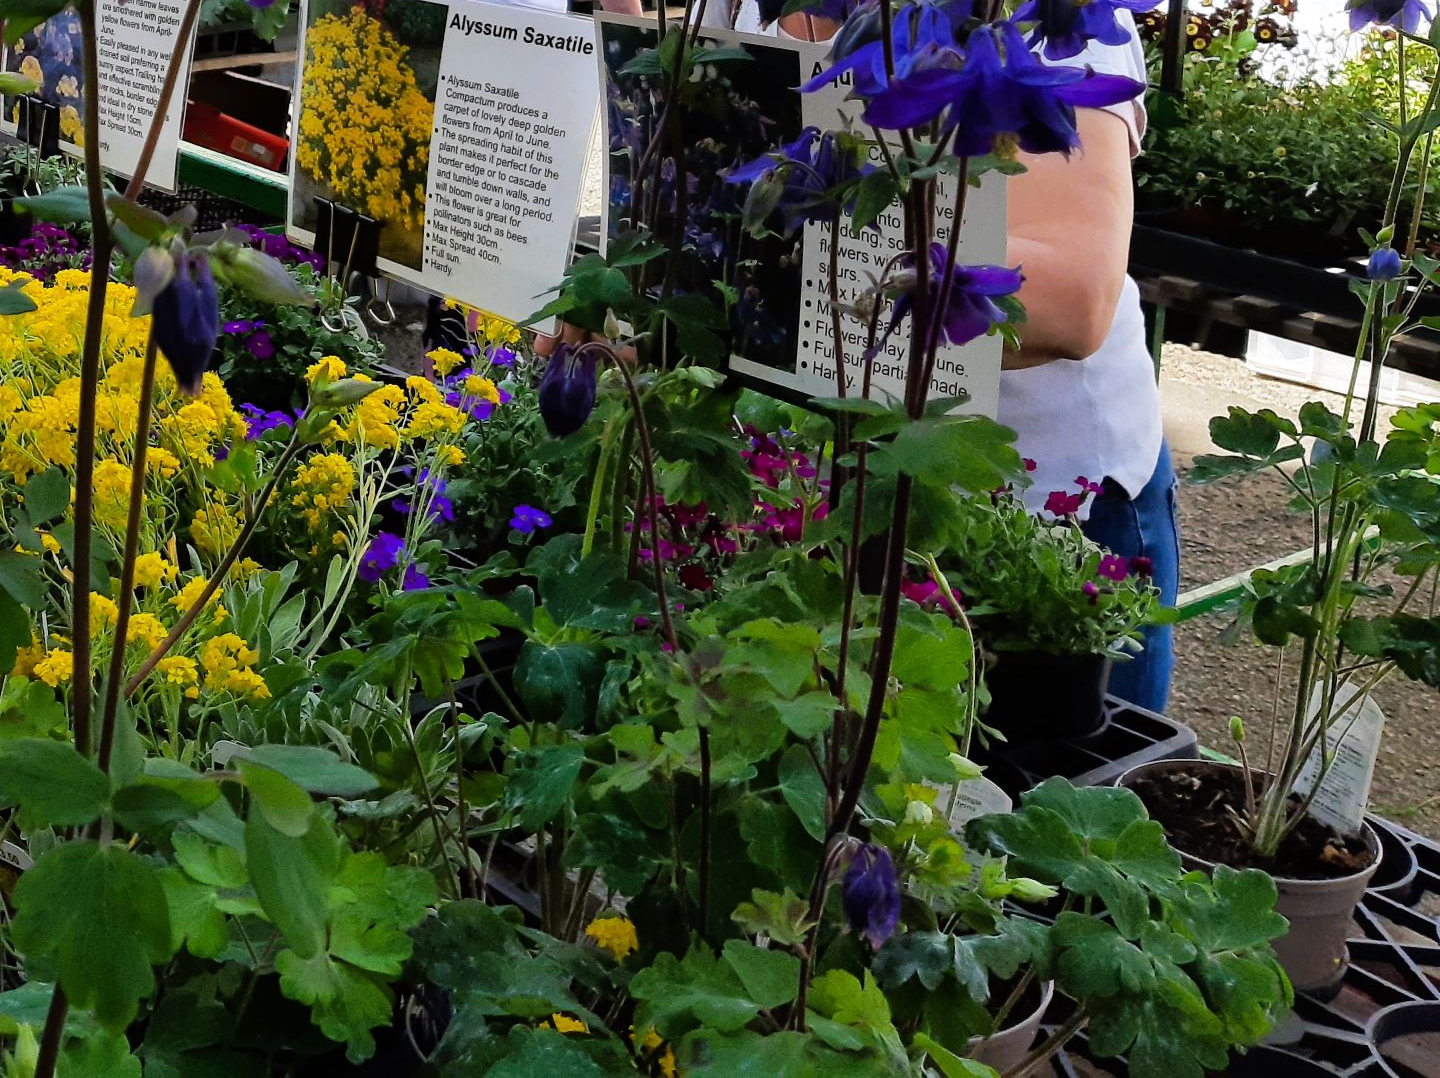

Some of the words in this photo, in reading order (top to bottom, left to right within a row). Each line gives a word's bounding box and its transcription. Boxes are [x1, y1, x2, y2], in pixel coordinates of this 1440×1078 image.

[141, 23, 155, 33] from
[144, 11, 156, 21] with
[158, 14, 180, 27] golden
[449, 13, 518, 41] Alyssum
[523, 27, 594, 55] Saxatile
[117, 40, 140, 54] pleased
[147, 49, 159, 60] any
[447, 75, 482, 90] Alyssum
[484, 83, 520, 99] Saxatile
[445, 88, 495, 108] Compactum
[498, 102, 539, 118] produces
[542, 112, 548, 120] a
[442, 114, 470, 130] flowers
[472, 121, 491, 135] from
[493, 127, 513, 141] April
[515, 132, 524, 142] to
[526, 135, 551, 150] June.
[444, 103, 469, 117] carpet
[471, 108, 480, 117] of
[481, 110, 506, 127] lovely
[509, 117, 531, 131] deep
[533, 123, 566, 138] golden
[441, 127, 456, 140] The
[458, 133, 498, 153] spreading
[500, 143, 523, 157] habit
[524, 149, 535, 159] of
[536, 152, 553, 164] this
[438, 154, 464, 169] border
[465, 161, 485, 176] edge
[487, 169, 496, 178] or
[498, 171, 506, 181] to
[508, 174, 547, 192] cascade
[439, 142, 458, 154] plant
[460, 147, 487, 162] makes
[489, 153, 494, 164] it
[496, 157, 527, 173] perfect
[529, 163, 542, 175] for
[544, 167, 559, 180] the
[437, 168, 451, 180] and
[453, 172, 479, 188] tumble
[481, 181, 503, 195] down
[505, 187, 530, 203] walls,
[532, 196, 551, 207] and
[435, 182, 447, 192] will
[449, 184, 472, 200] bloom
[474, 193, 492, 205] over
[494, 199, 500, 207] a
[502, 199, 521, 216] long
[522, 207, 554, 223] period.
[435, 193, 450, 207] This
[452, 198, 475, 214] flower
[477, 208, 483, 217] is
[485, 211, 507, 224] great
[509, 216, 521, 228] for
[432, 220, 448, 233] Max
[450, 225, 474, 242] Height
[433, 208, 471, 227] pollinators
[473, 221, 492, 233] such
[494, 227, 504, 237] as
[431, 245, 444, 258] Full
[432, 232, 447, 246] Max
[449, 239, 476, 256] Spread
[818, 278, 847, 300] Mx
[813, 360, 856, 388] Hary.
[936, 356, 969, 378] une.
